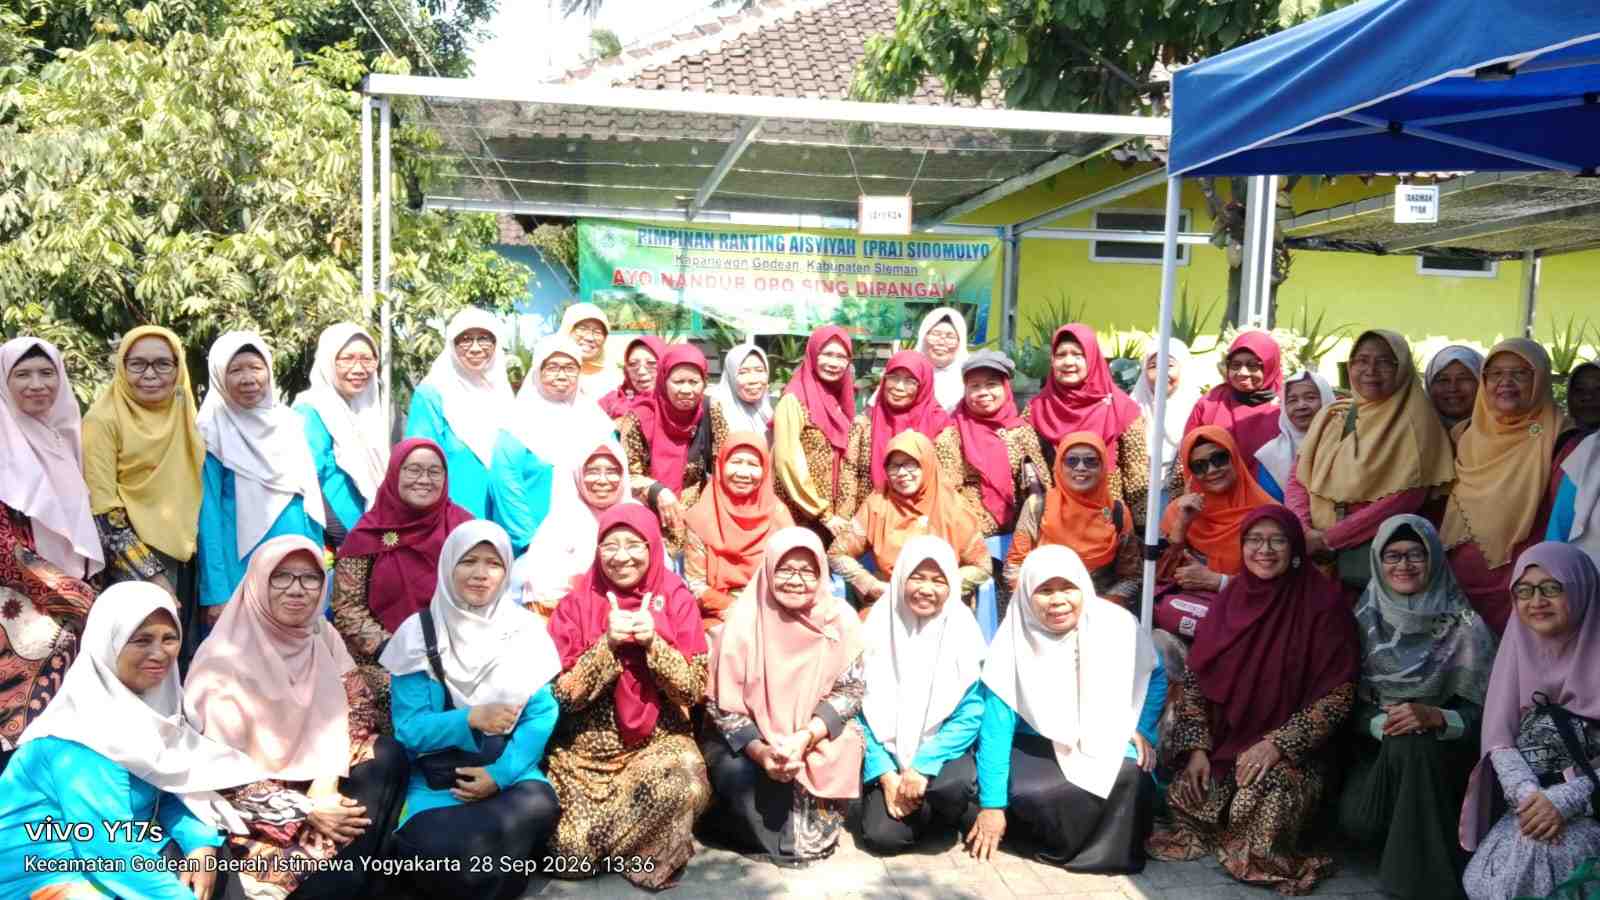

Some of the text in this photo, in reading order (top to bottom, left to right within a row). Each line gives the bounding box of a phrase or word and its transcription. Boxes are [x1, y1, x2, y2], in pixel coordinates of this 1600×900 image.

[637, 228, 714, 249] PIMPINAN
[719, 233, 785, 253] RANTING
[790, 236, 856, 255] AISYIYAH
[907, 241, 991, 259] SIDOMULYO
[807, 260, 871, 274] Kabupaten
[874, 263, 918, 275] Sleman
[613, 269, 652, 286] AYO
[754, 277, 795, 292] OPO
[801, 278, 849, 296] SING
